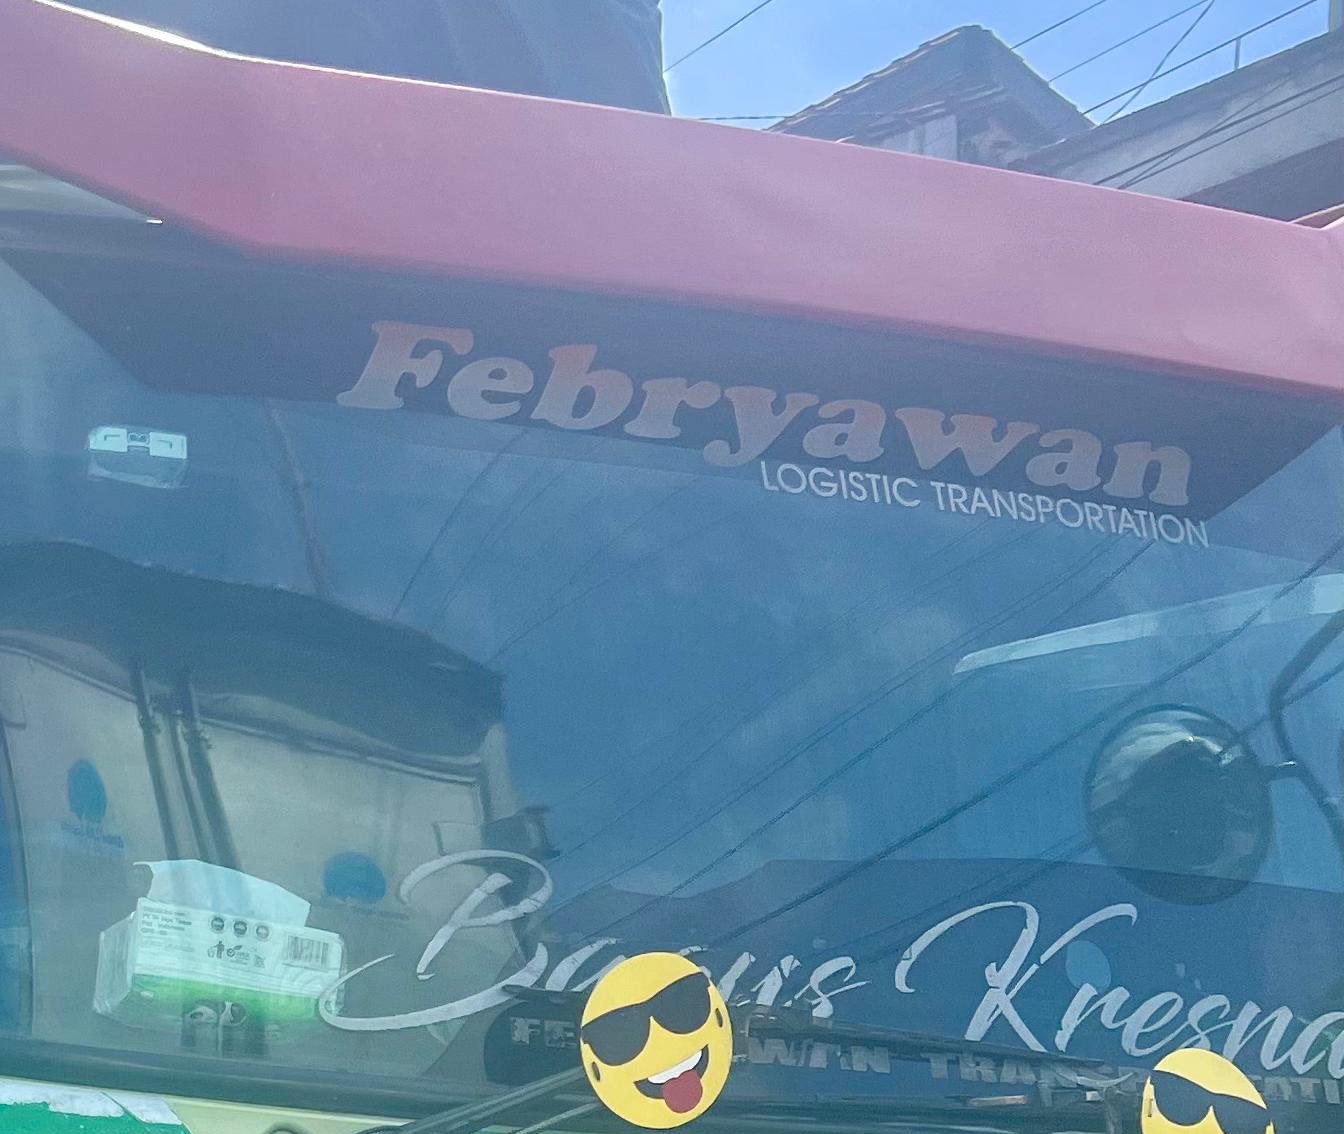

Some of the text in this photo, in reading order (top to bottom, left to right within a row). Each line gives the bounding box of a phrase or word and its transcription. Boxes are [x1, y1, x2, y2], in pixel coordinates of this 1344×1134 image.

[337, 320, 1193, 507] Febryawan
[760, 460, 1210, 548] LOGISTIC TRANSPORTATION
